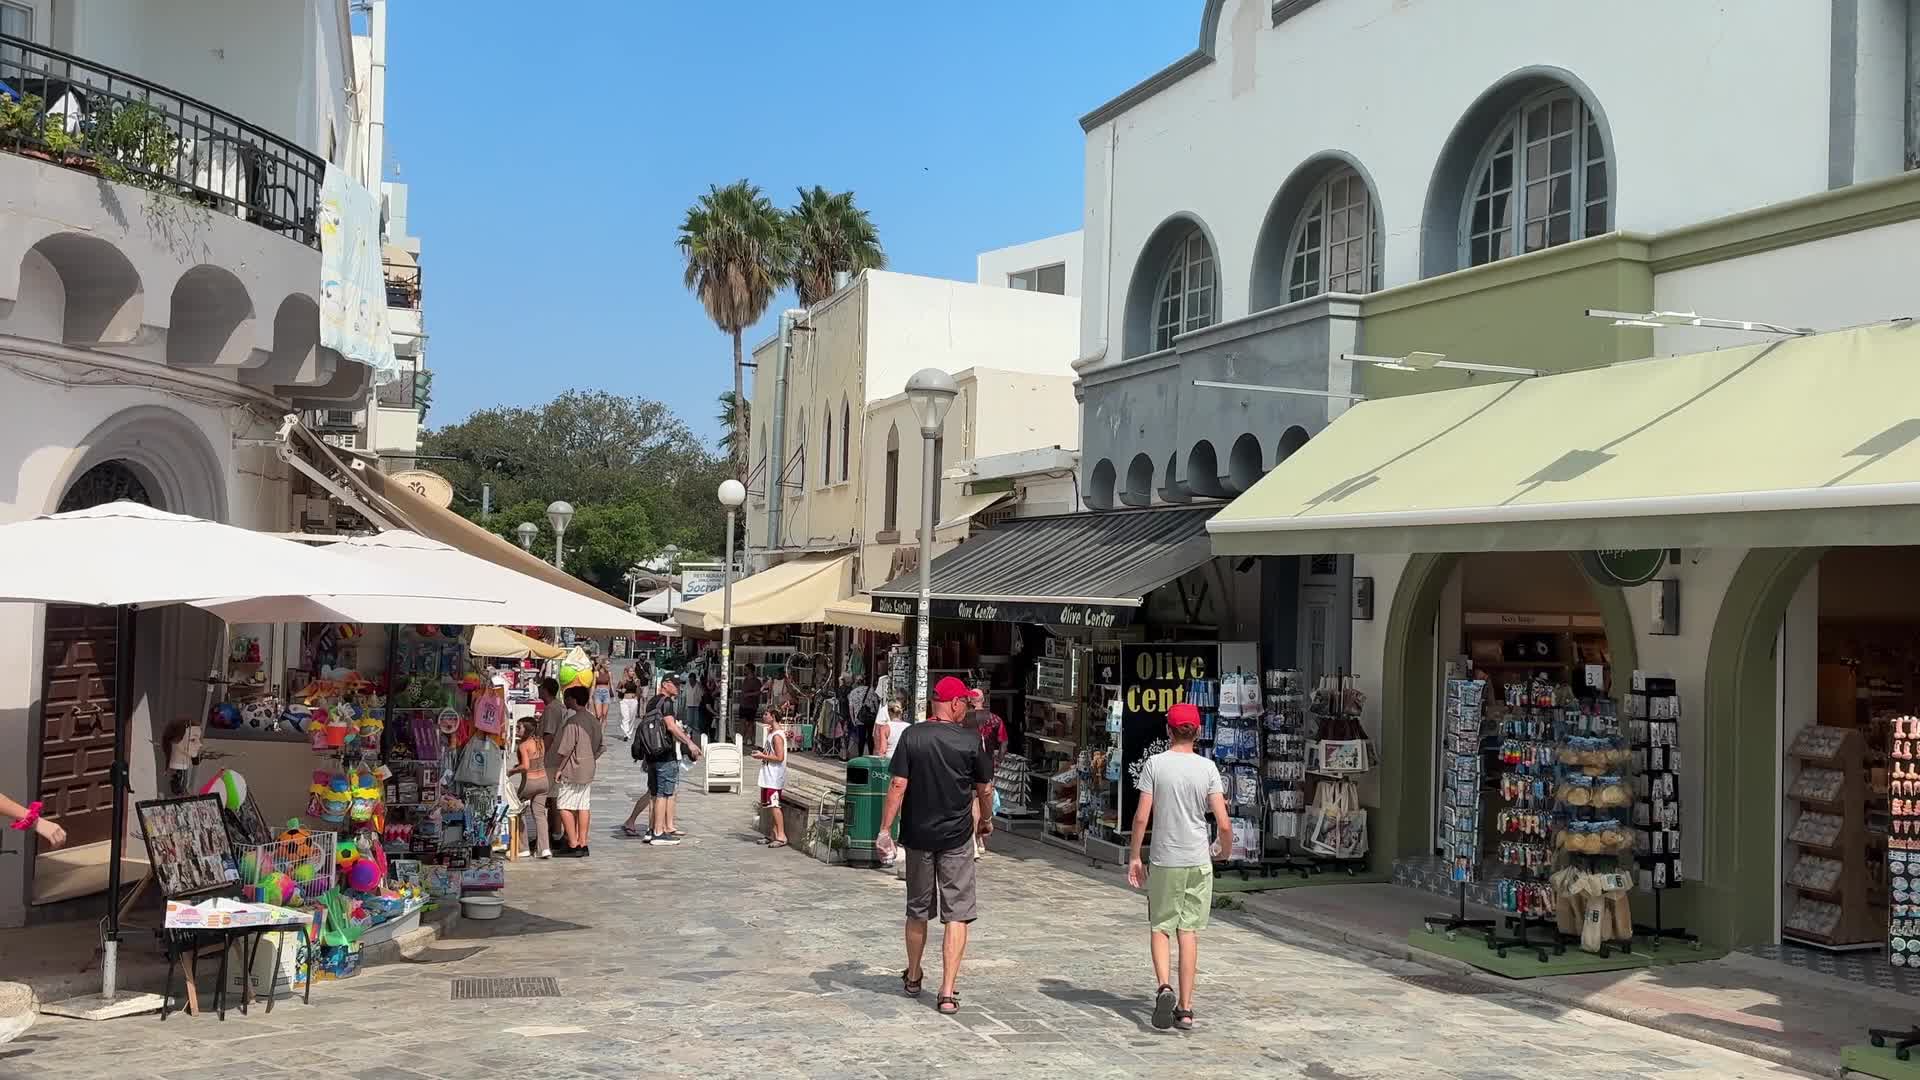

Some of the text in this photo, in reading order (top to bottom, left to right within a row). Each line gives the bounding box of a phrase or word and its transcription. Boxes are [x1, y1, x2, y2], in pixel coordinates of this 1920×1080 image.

[687, 581, 726, 593] Socrat
[894, 601, 912, 614] Center
[958, 602, 998, 620] Olive Center
[1060, 604, 1116, 627] Olive Center
[1136, 652, 1206, 680] Olive
[1127, 684, 1185, 713] Cent
